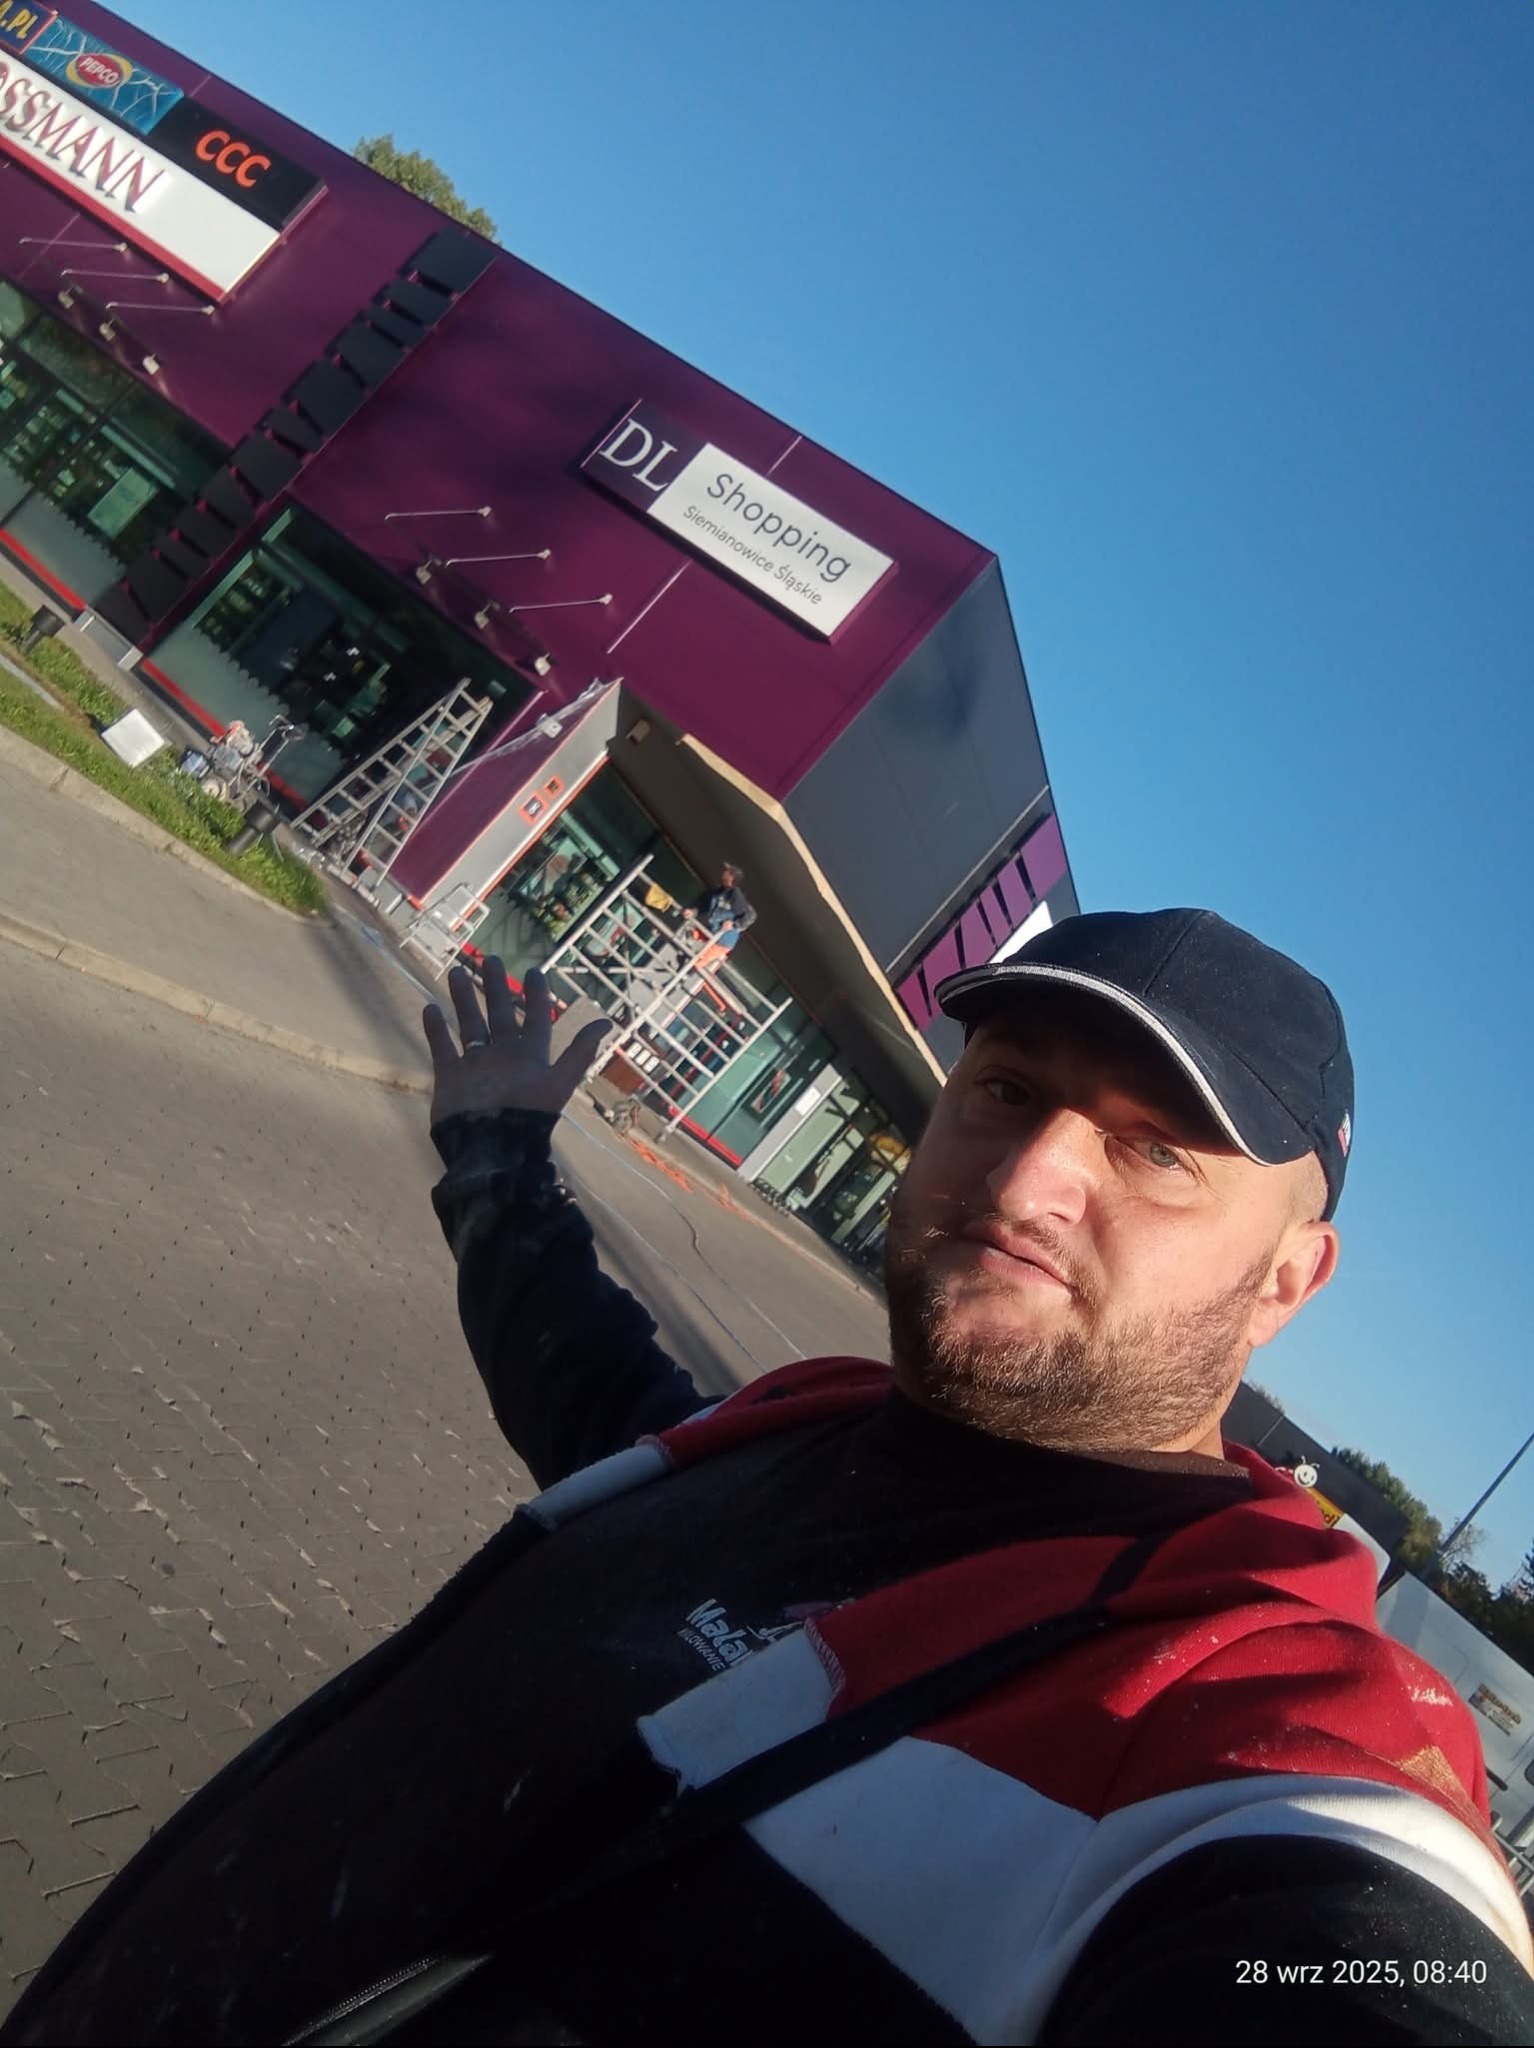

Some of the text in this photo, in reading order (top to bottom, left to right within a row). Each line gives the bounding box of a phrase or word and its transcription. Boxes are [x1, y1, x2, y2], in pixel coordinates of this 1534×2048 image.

[78, 55, 120, 85] PEPCO
[195, 130, 272, 188] CCC
[598, 418, 678, 492] DL
[683, 505, 822, 604] Siemianowice Śląskie
[707, 473, 851, 583] Shopping
